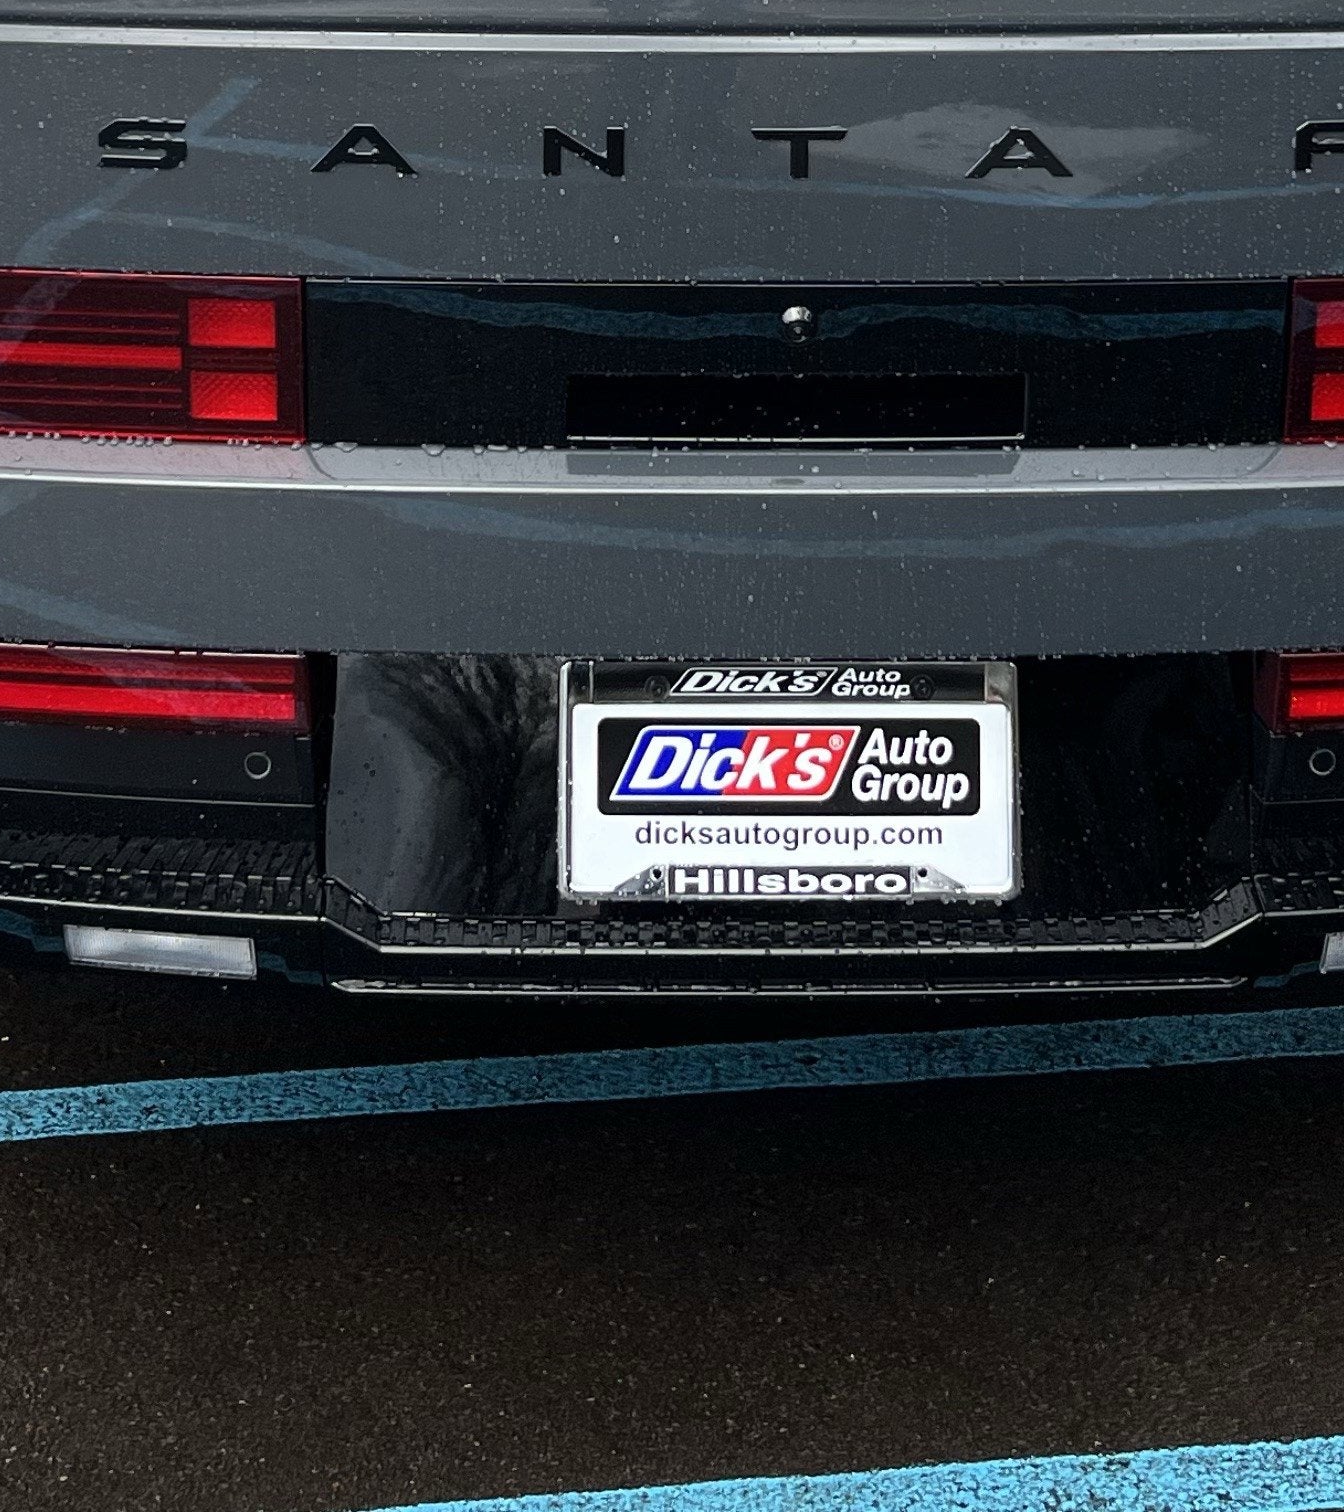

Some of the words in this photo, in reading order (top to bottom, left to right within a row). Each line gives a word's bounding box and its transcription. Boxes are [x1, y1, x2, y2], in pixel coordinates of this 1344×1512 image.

[96, 117, 1074, 179] SANTA
[680, 669, 820, 693] Dick's
[838, 667, 902, 683] Auto
[831, 682, 911, 699] Group
[627, 732, 833, 790] Dick's
[857, 727, 953, 765] Auto
[851, 764, 969, 809] Group
[634, 821, 943, 851] dicksautogroup.com
[673, 868, 908, 895] Hillsboro
